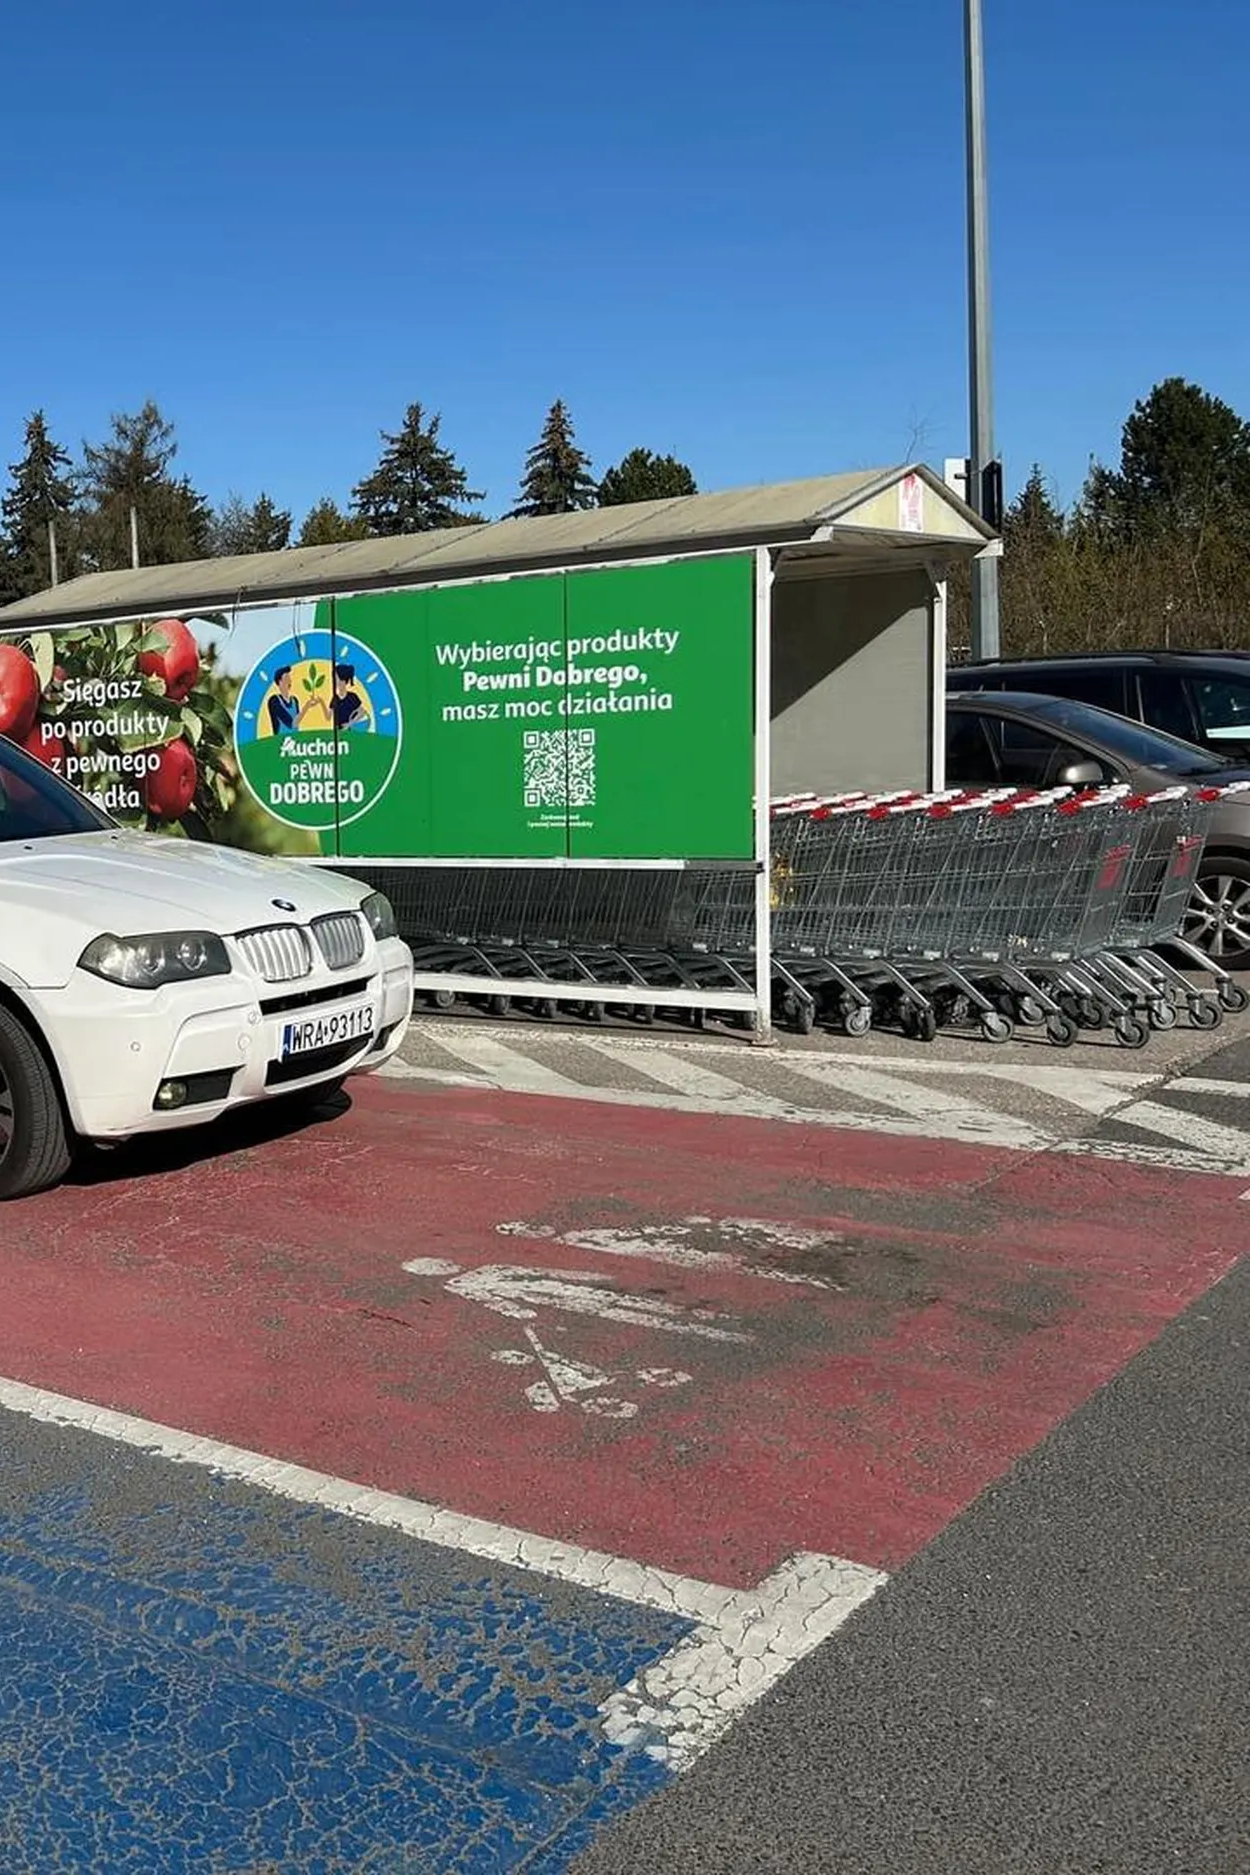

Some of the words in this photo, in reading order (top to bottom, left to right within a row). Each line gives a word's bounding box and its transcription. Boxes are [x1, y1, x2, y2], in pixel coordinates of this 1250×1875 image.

[435, 636, 562, 669] Wybierając
[567, 627, 680, 661] produkty
[463, 665, 531, 692] Pewni
[536, 663, 648, 688] Dobrego,
[63, 678, 142, 707] Sięgasz
[442, 702, 500, 721] masz
[505, 699, 553, 718] moc
[558, 687, 673, 716] działania
[41, 721, 66, 746] po
[71, 710, 169, 740] produkty
[280, 737, 349, 757] Auchan
[51, 758, 62, 774] z
[66, 753, 161, 779] pewnego
[290, 763, 334, 779] PEWN
[270, 780, 364, 804] DOBREGO
[293, 1021, 325, 1051] WRA
[329, 1007, 373, 1042] 93113
